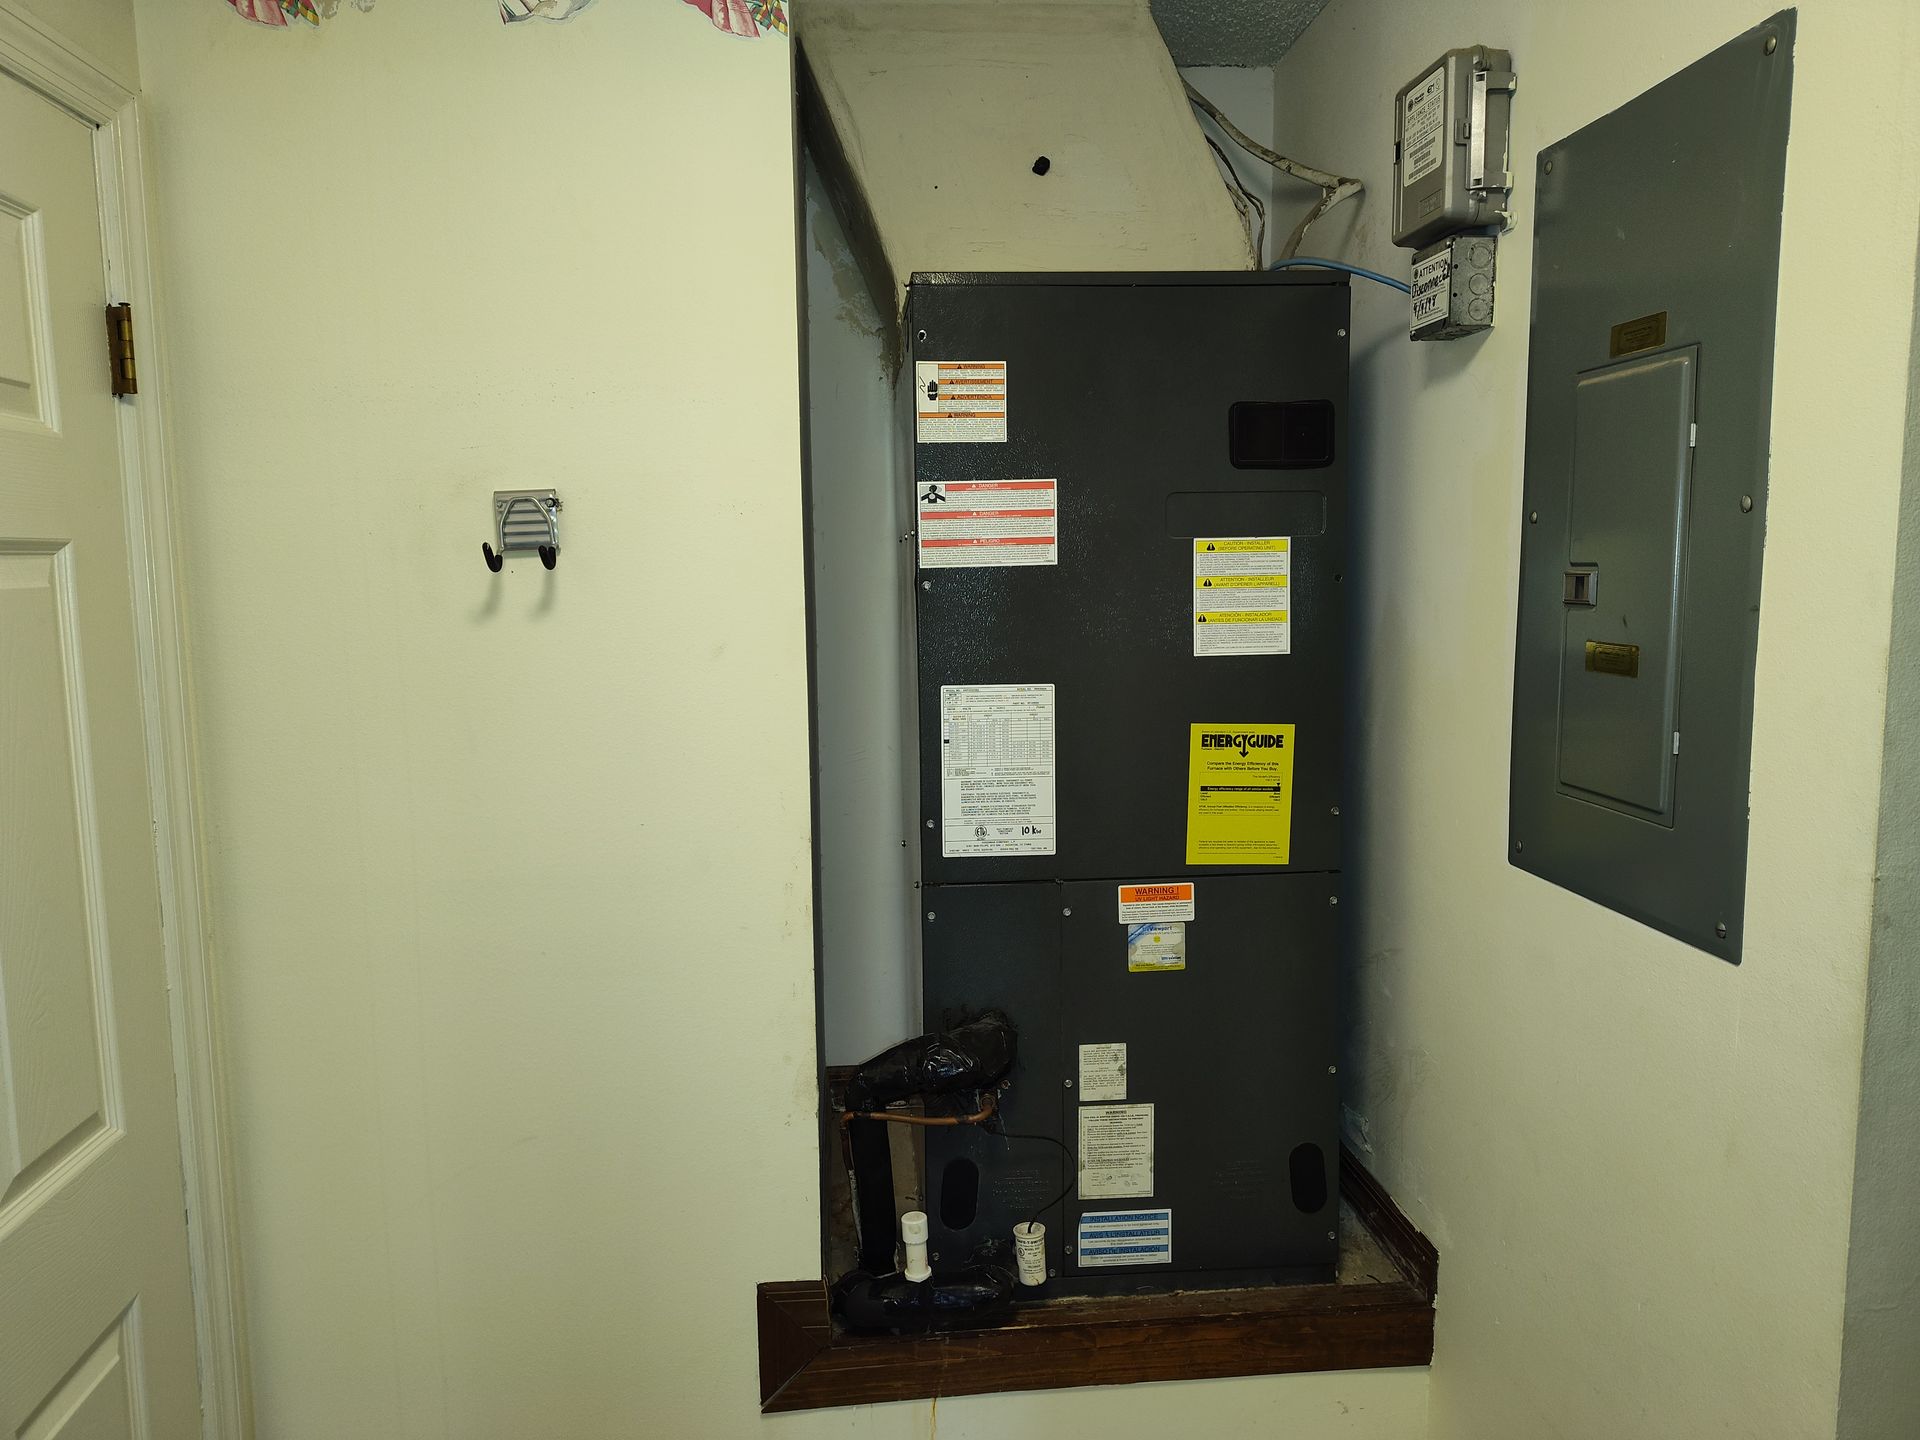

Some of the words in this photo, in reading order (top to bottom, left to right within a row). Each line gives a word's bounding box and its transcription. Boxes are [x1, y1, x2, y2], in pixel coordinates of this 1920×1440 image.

[1427, 95, 1441, 110] STATUS
[1418, 257, 1449, 278] ATTENTION
[1021, 826, 1030, 836] 10
[1135, 887, 1174, 895] WARNING
